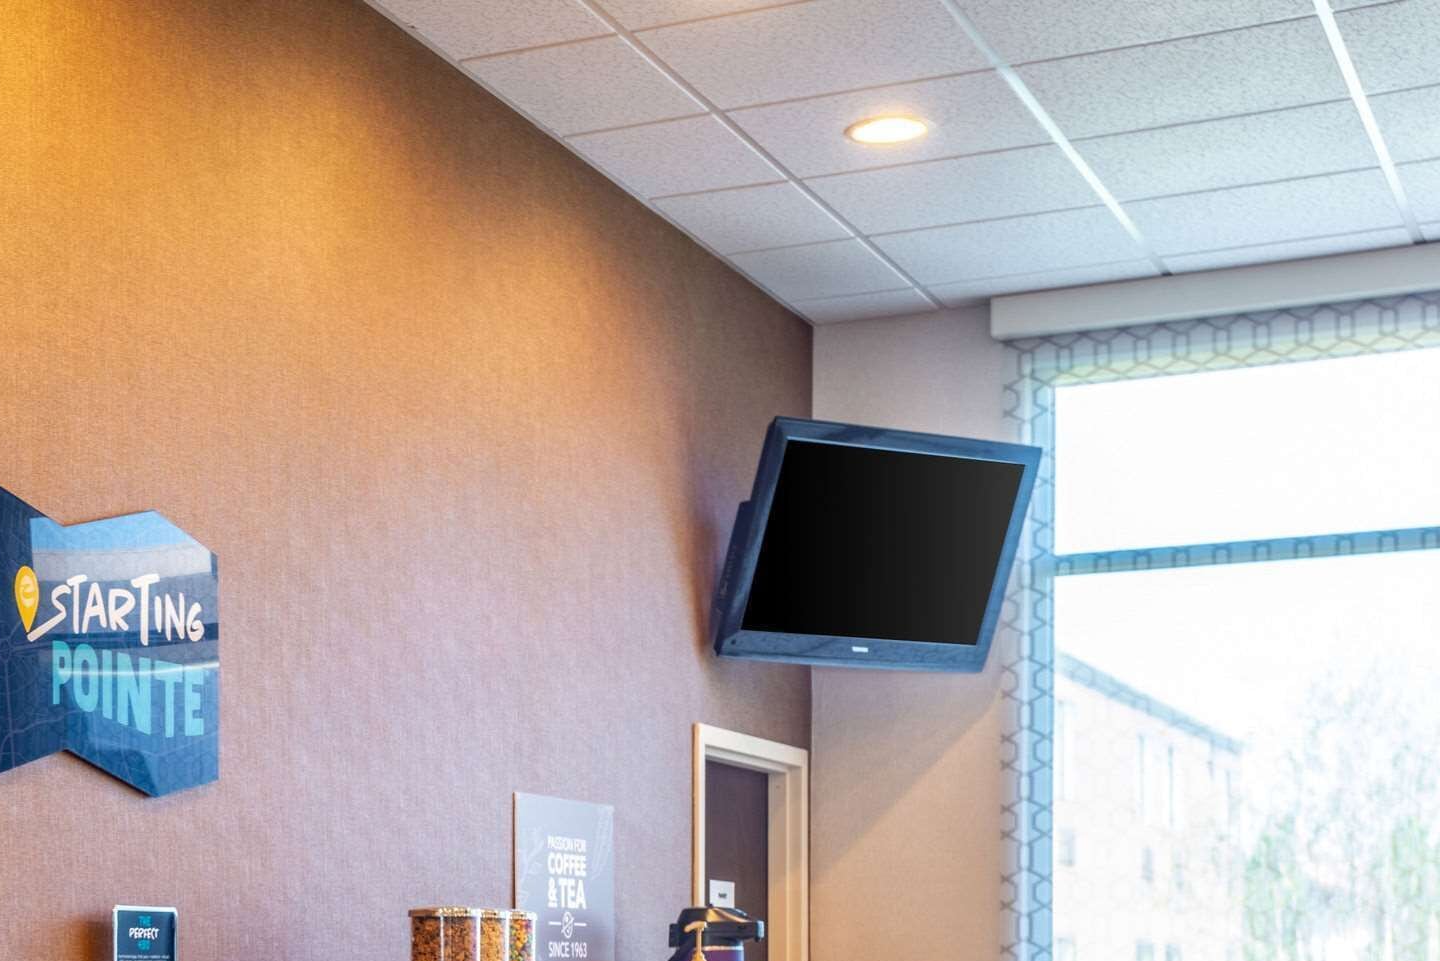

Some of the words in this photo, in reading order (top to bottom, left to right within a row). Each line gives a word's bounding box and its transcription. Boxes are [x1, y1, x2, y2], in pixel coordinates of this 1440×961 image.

[27, 573, 205, 646] STARTING
[52, 640, 205, 738] POINTE
[574, 838, 587, 853] FOR
[547, 851, 587, 877] COFFEE
[547, 877, 558, 908] &
[558, 877, 587, 910] TEA
[128, 927, 160, 940] PERFECT
[548, 941, 570, 958] SINCE
[571, 941, 588, 958] 1963
